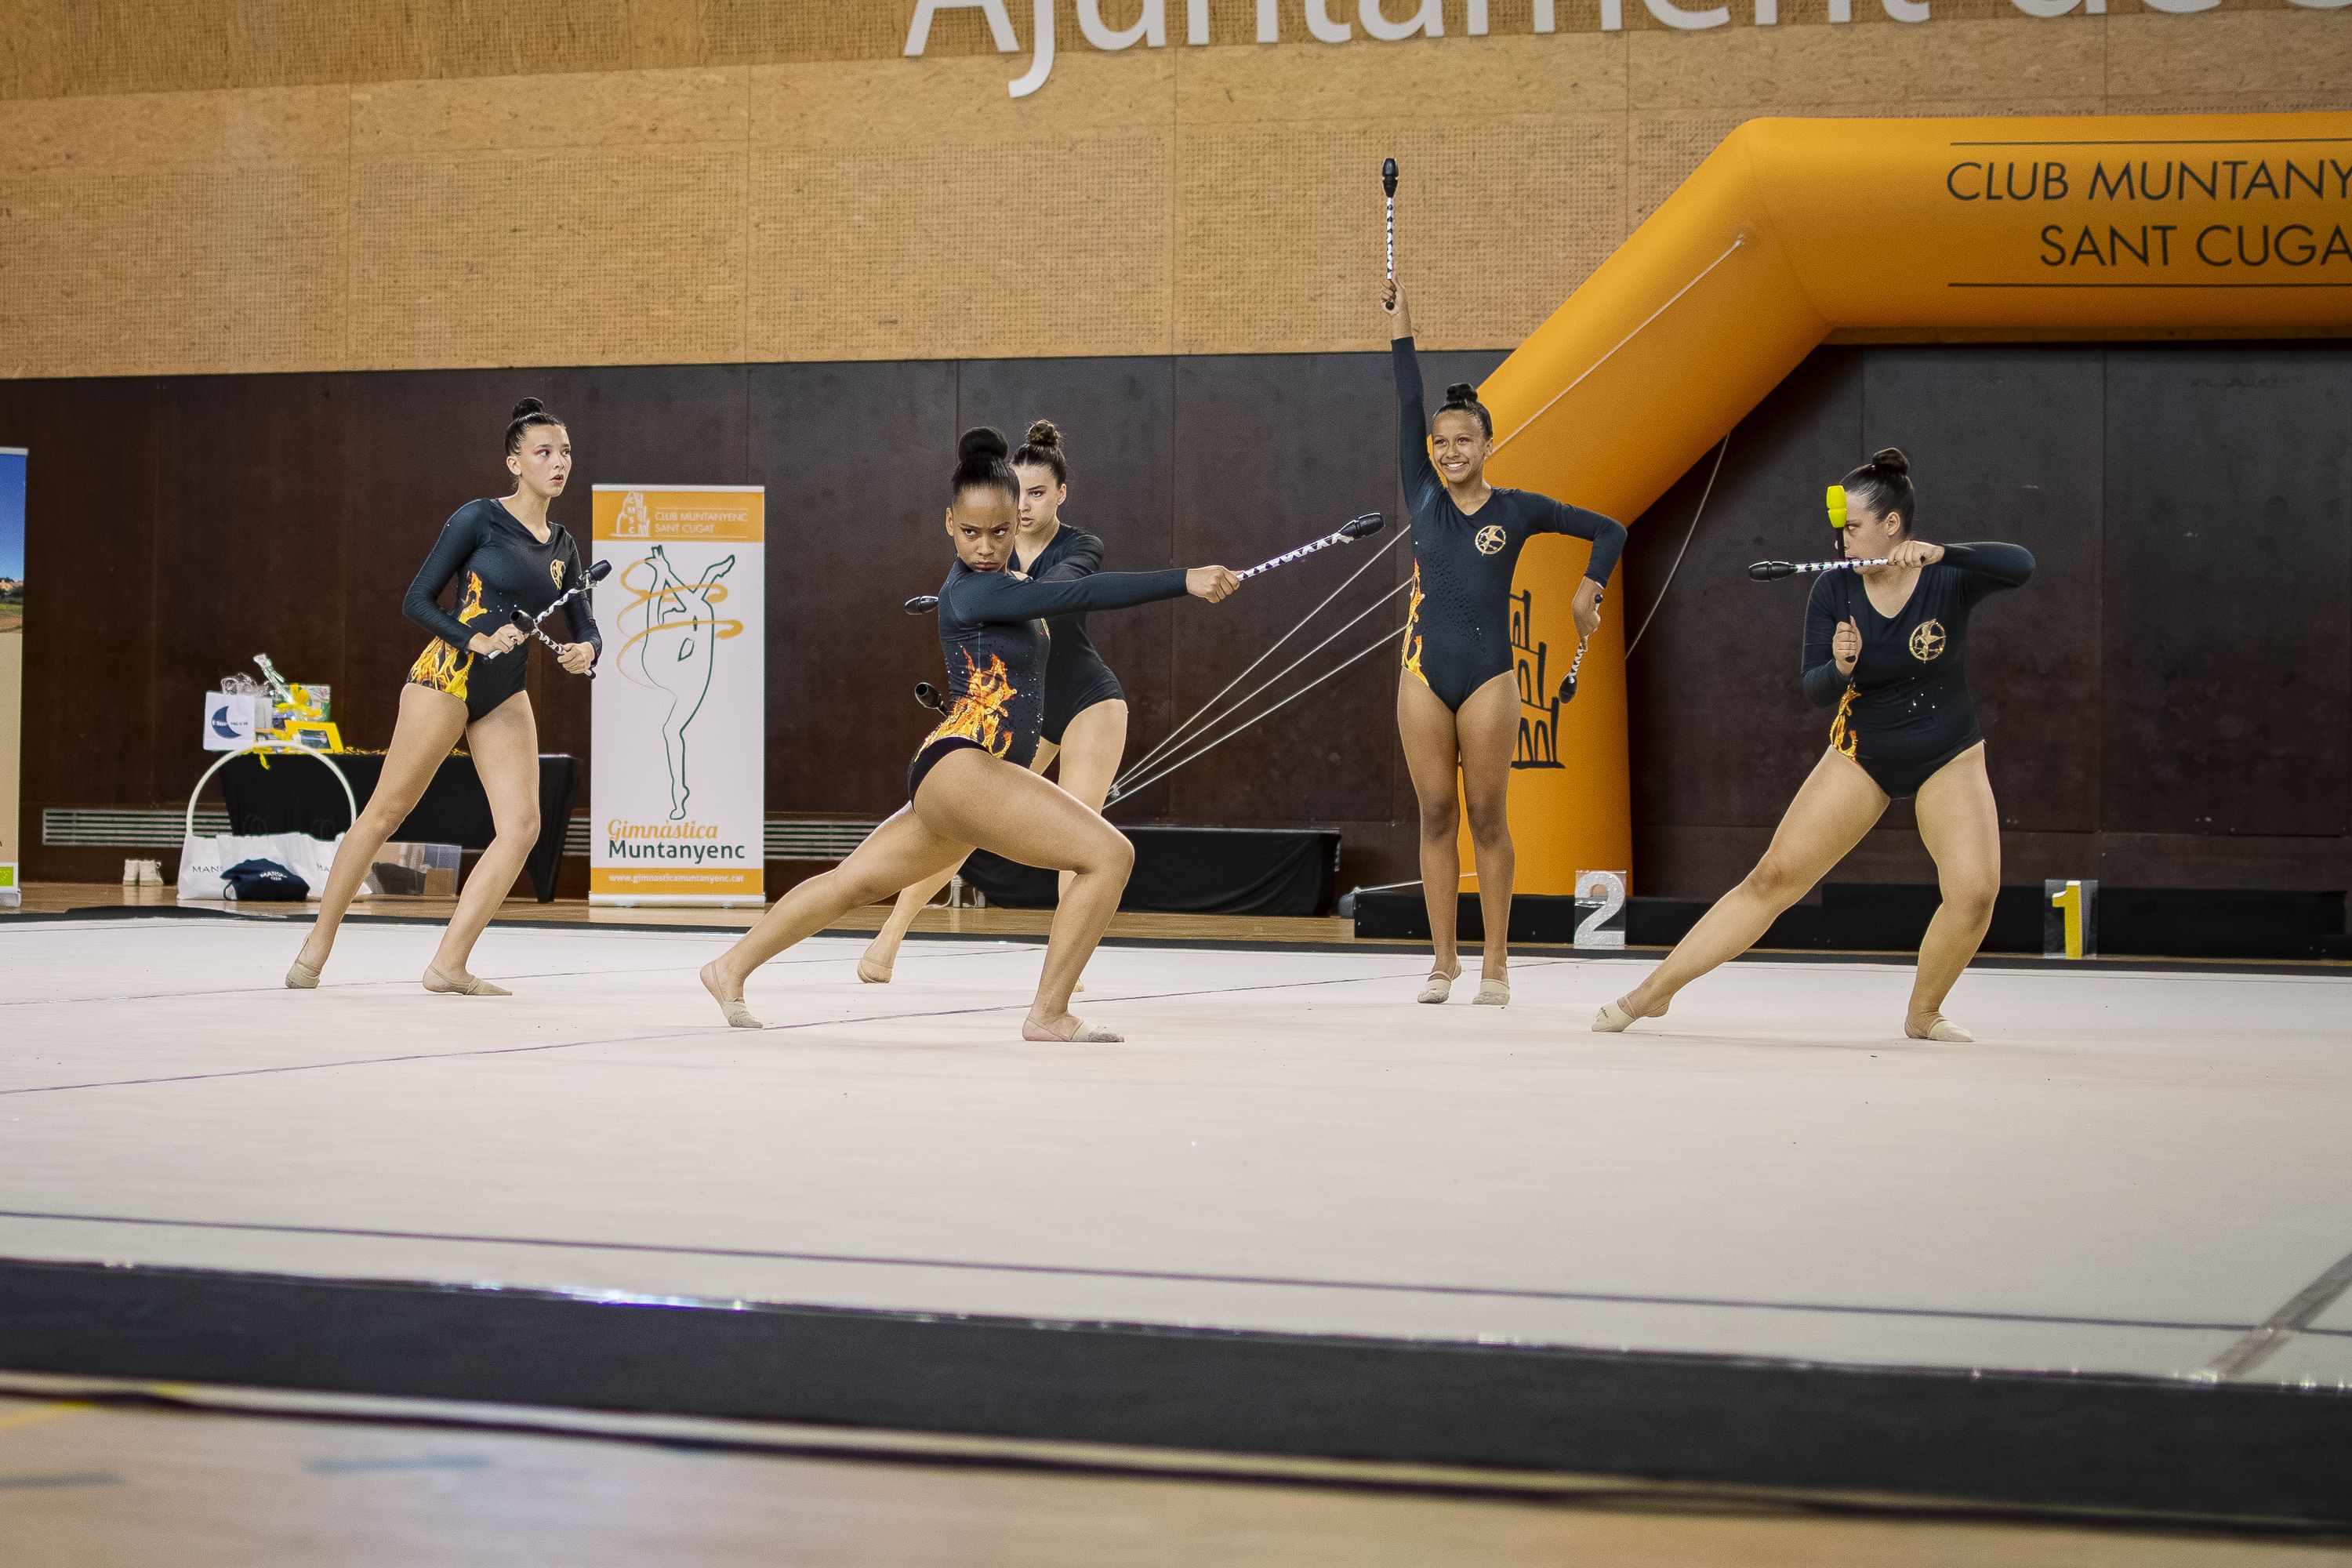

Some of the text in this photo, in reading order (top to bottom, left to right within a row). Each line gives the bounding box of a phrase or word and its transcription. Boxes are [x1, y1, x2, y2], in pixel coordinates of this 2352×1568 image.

[1947, 158, 2352, 201] CLUB MUNTANY
[2040, 223, 2352, 267] SANT CUGA
[654, 512, 749, 523] CLUB MUNTANYENC
[654, 523, 716, 534] SANT CUGAT
[608, 840, 746, 865] Muntanyenc
[608, 873, 745, 884] www.gimnasticamuntanyenc.cat
[1574, 870, 1626, 947] 2
[2052, 880, 2082, 960] 1
